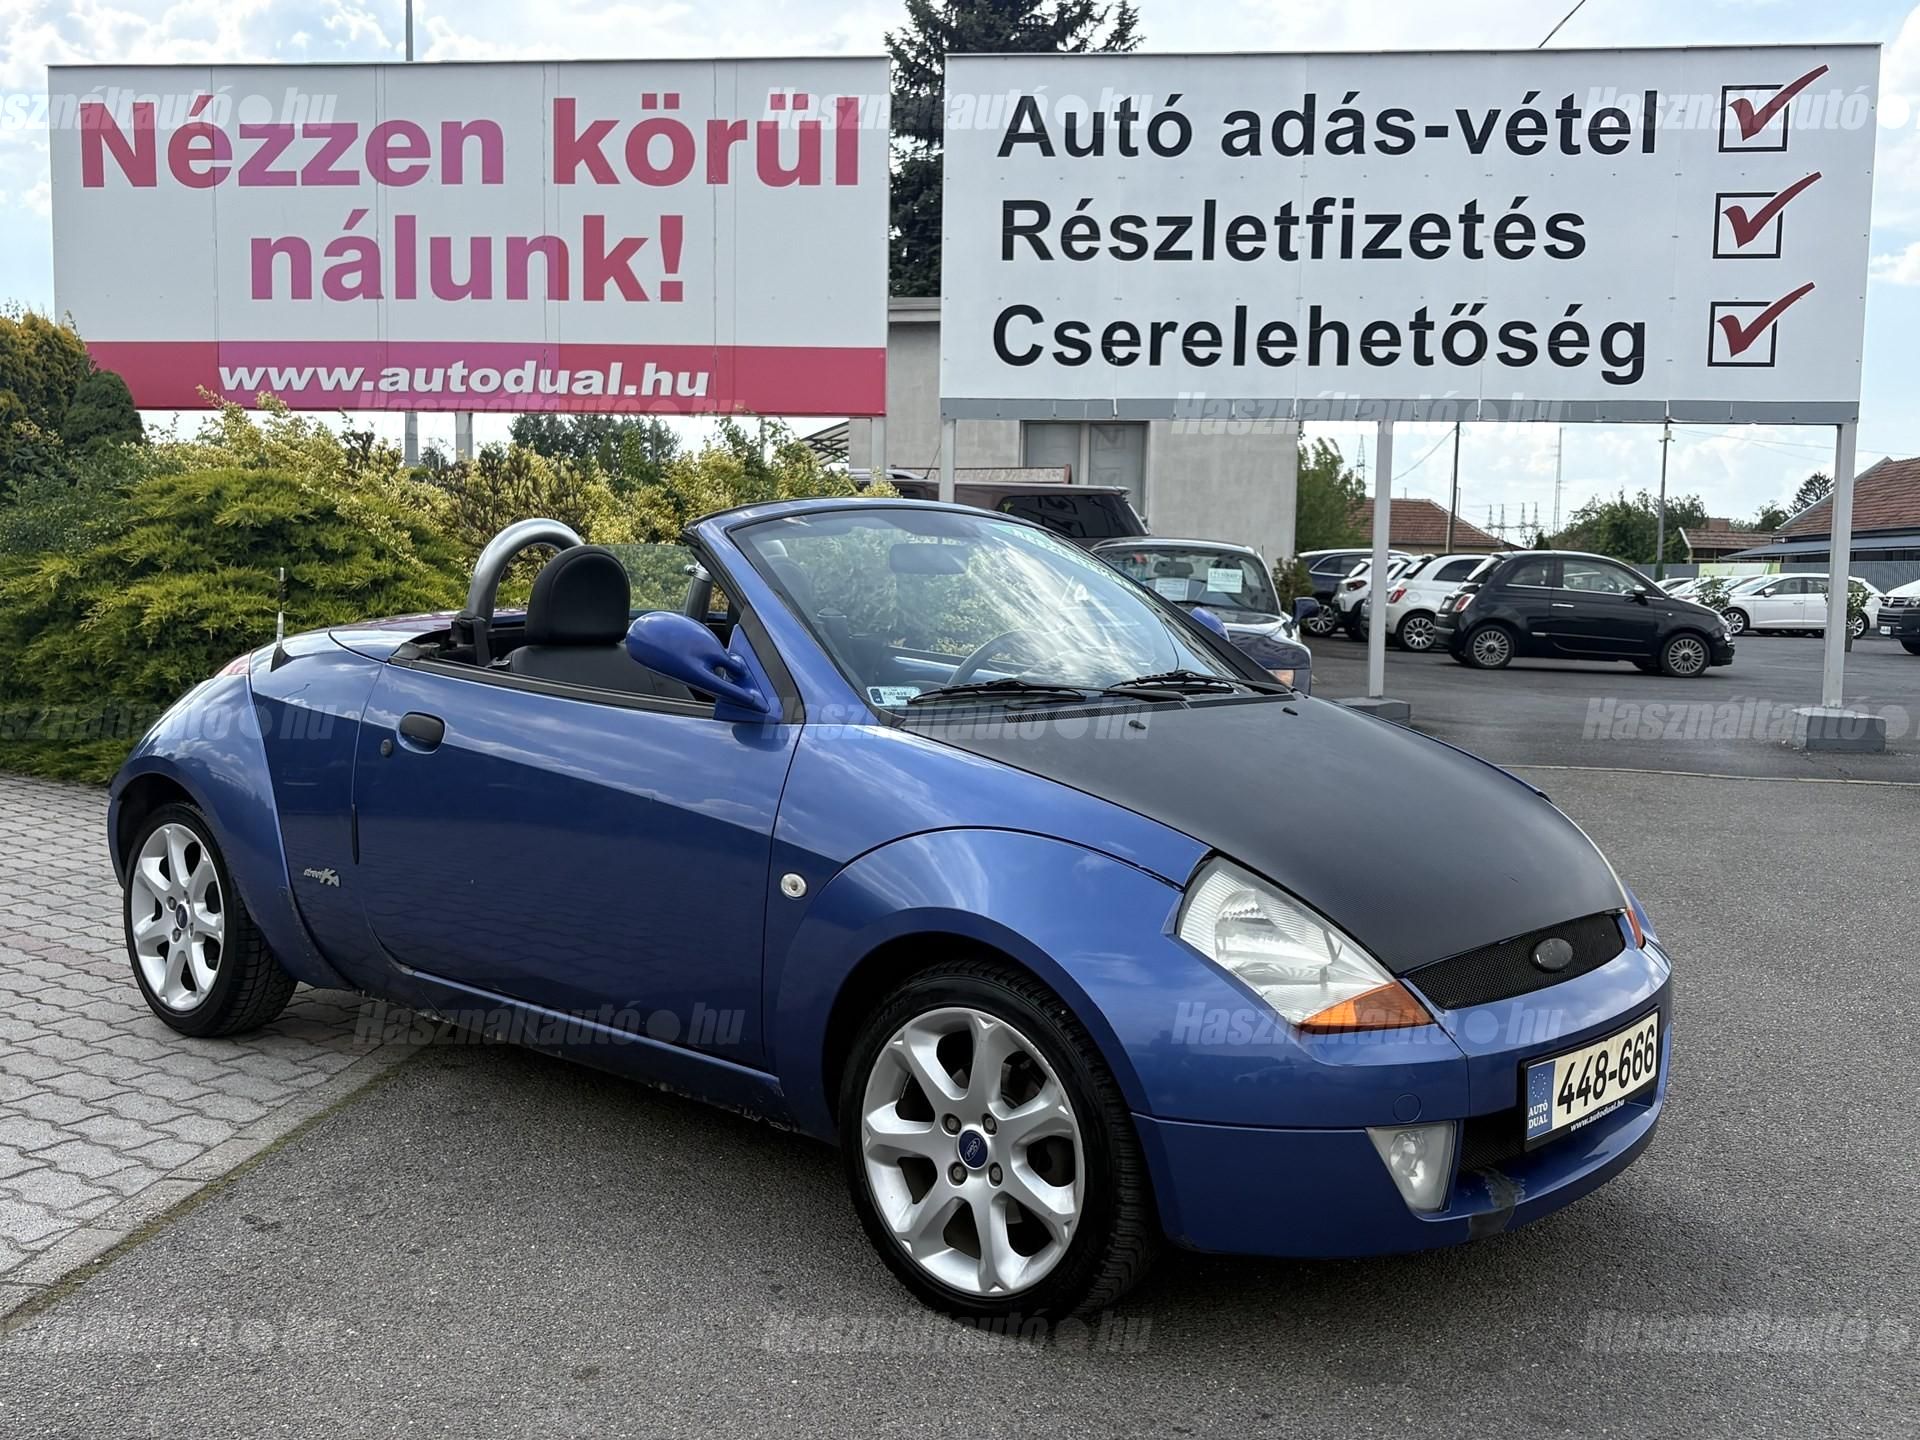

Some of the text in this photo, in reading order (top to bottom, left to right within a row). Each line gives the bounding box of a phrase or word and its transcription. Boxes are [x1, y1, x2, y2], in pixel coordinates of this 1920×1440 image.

[83, 93, 859, 189] Nézzen körül
[997, 90, 1658, 158] Autó adás-vétel
[251, 209, 684, 303] nálunk!
[1002, 196, 1587, 262] Részletfizetés
[219, 361, 709, 398] www.autodual.hu
[993, 303, 1647, 385] Cserelehetőség
[1557, 1023, 1656, 1116] 448-666
[1528, 1113, 1549, 1129] DUAL
